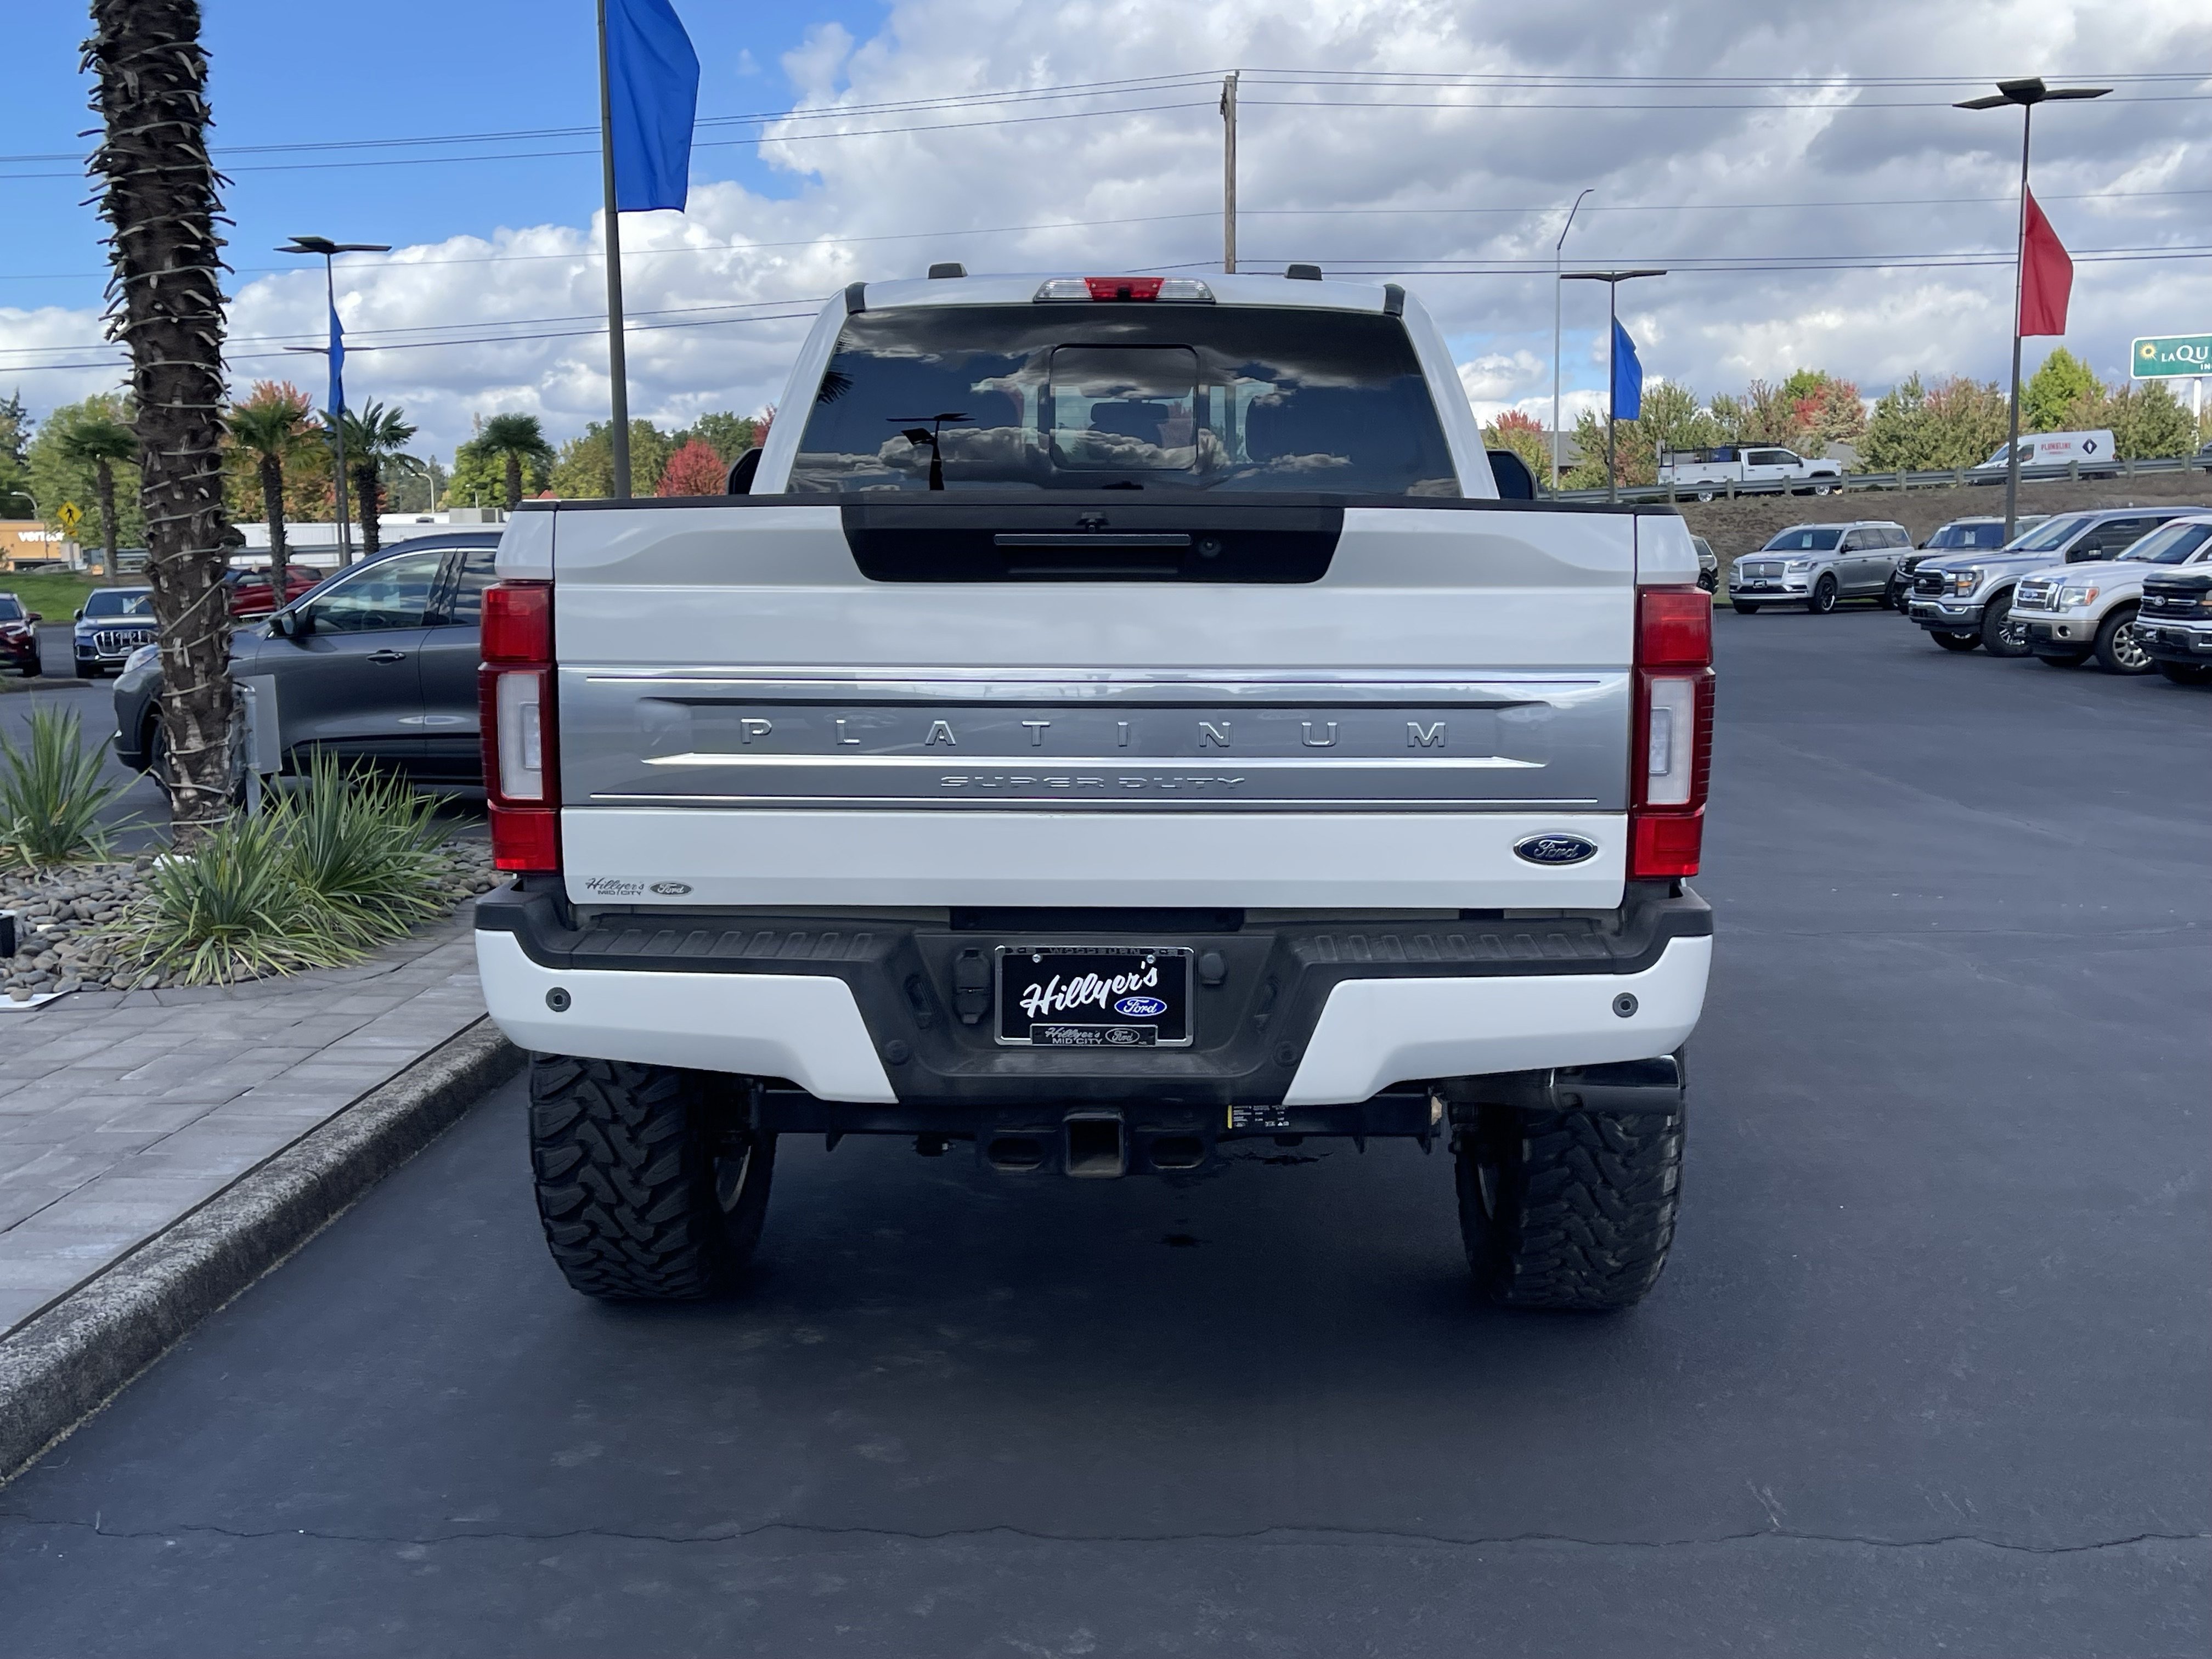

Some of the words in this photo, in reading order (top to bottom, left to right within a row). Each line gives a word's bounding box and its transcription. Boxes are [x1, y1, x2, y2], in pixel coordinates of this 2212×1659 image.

[2161, 353, 2175, 362] LA
[2176, 345, 2212, 364] QU
[741, 717, 1447, 748] PLATINUM
[941, 776, 1104, 788] SUPER
[1119, 777, 1245, 789] DUTY
[1533, 839, 1581, 859] Ford
[585, 877, 645, 895] Hillyer's
[657, 883, 685, 894] Ford
[1020, 961, 1158, 1018] Hillyer's
[1123, 998, 1158, 1014] Ford
[1045, 1027, 1101, 1041] Hillyer's
[1111, 1030, 1133, 1042] Ford
